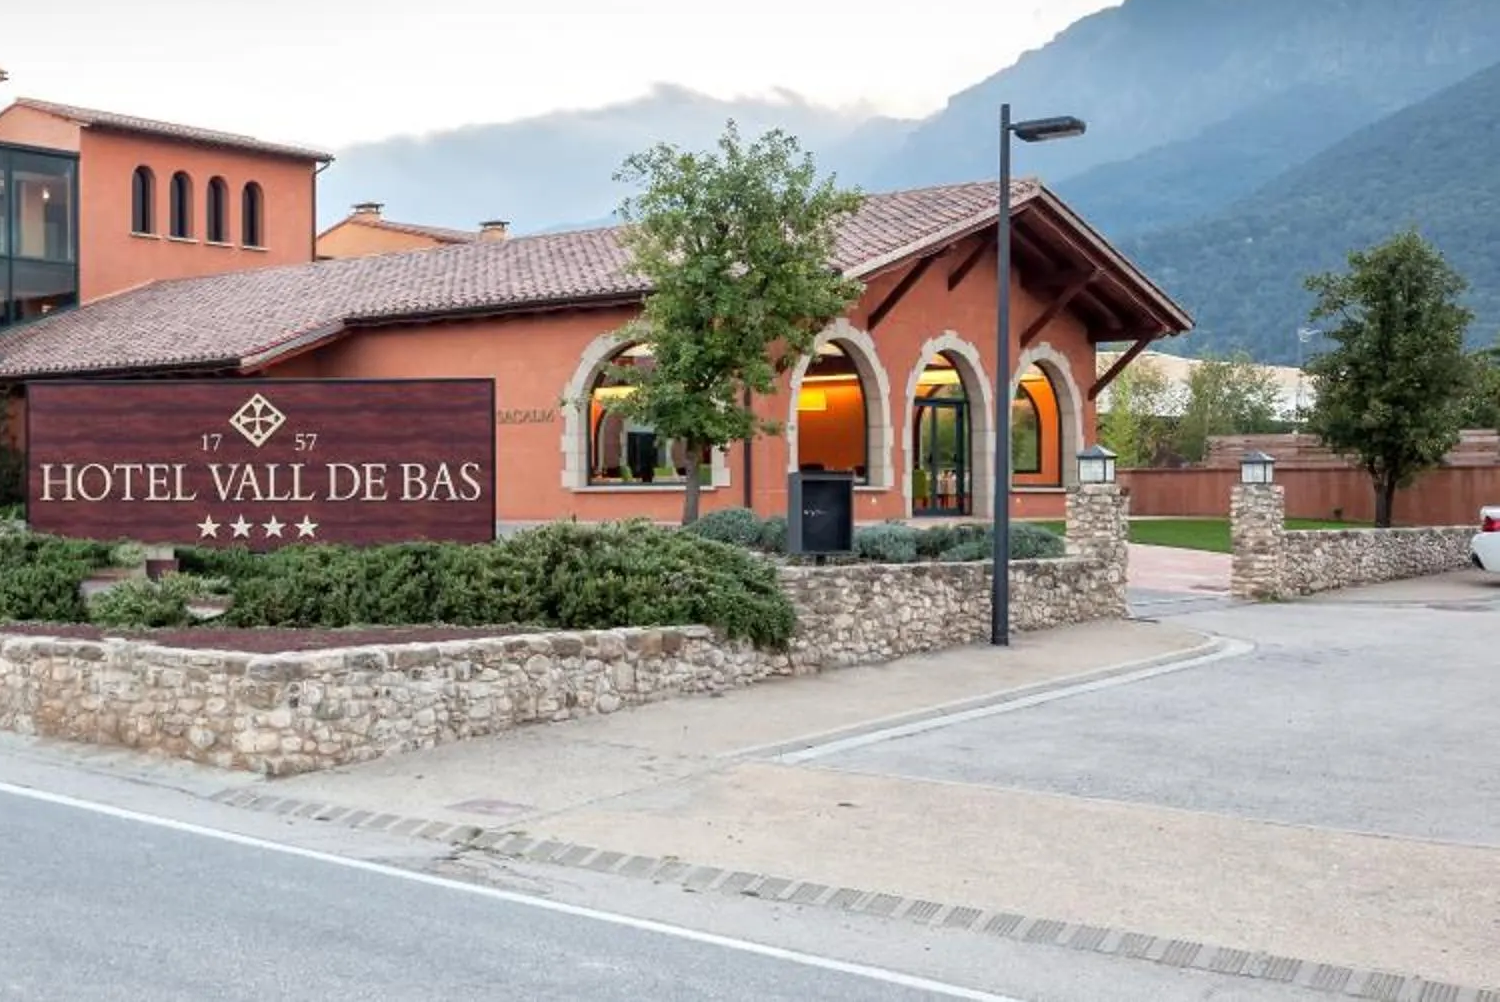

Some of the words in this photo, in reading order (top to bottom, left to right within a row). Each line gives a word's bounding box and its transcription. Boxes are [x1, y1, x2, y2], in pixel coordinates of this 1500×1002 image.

[201, 433, 222, 452] 17
[294, 433, 318, 451] 57
[40, 463, 197, 501] HOTEL
[208, 463, 315, 501] VALL
[325, 463, 388, 501] DE
[400, 462, 482, 501] BAS
